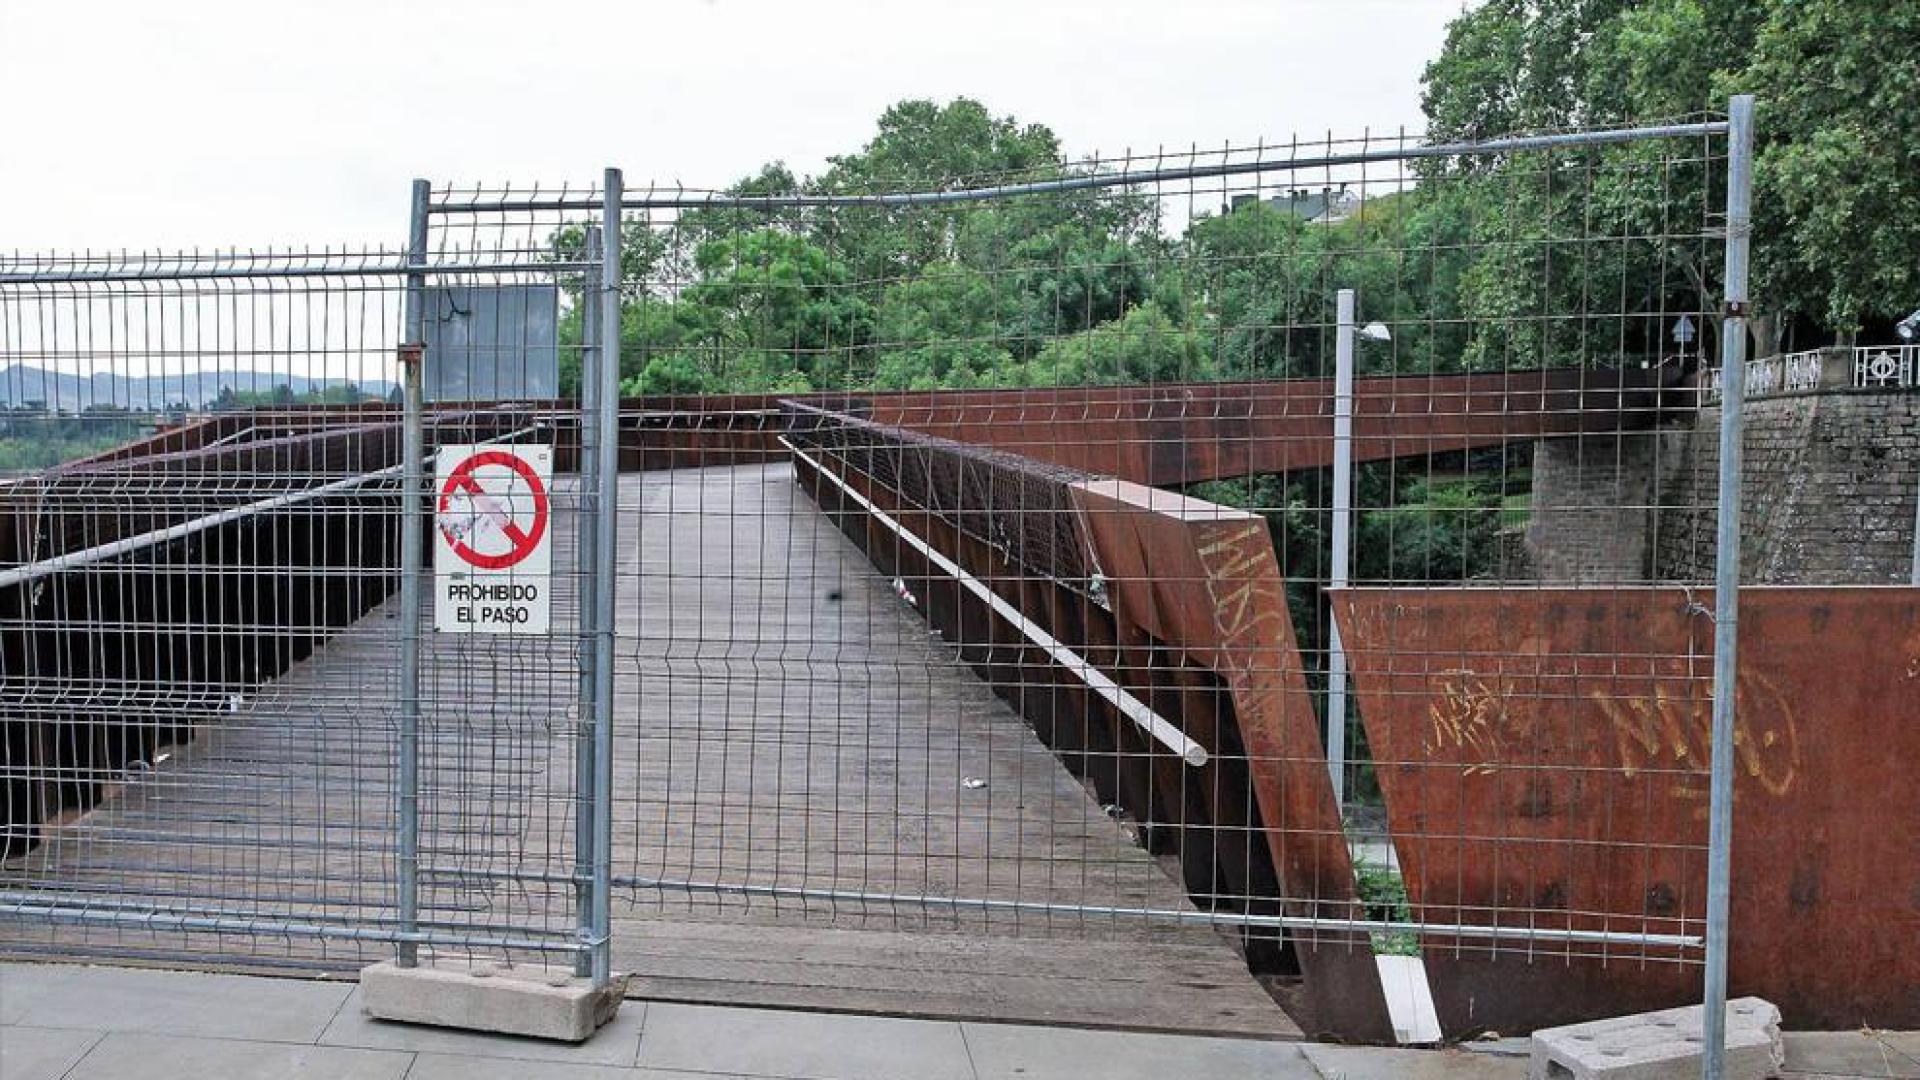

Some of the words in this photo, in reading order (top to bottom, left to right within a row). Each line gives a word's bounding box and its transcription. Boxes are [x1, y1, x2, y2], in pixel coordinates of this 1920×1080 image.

[448, 584, 538, 601] PROHIBIDO
[457, 606, 477, 623] EL
[482, 606, 529, 623] PASO
